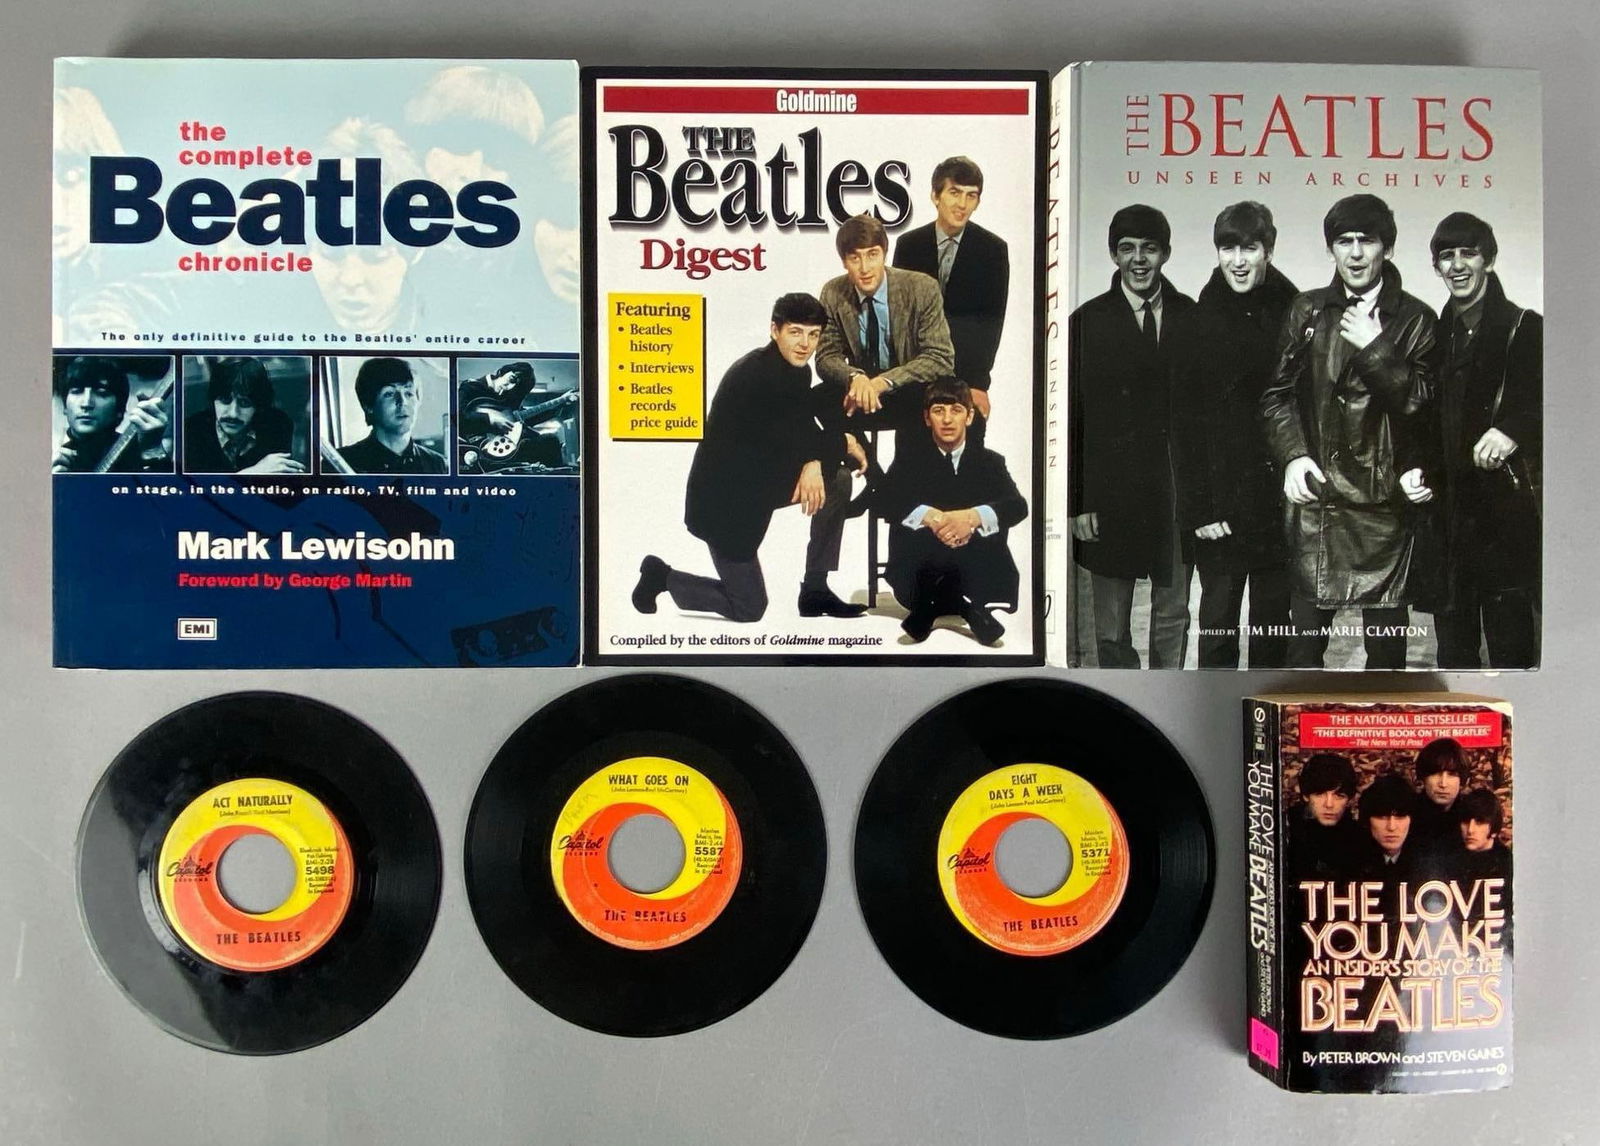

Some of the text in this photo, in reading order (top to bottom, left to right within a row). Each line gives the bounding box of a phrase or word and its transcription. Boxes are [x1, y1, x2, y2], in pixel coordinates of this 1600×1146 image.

[776, 89, 857, 113] Goldmine
[180, 122, 226, 141] the
[1126, 95, 1150, 156] THE
[1159, 93, 1495, 162] BEATLES
[682, 126, 756, 155] THE
[179, 147, 312, 169] complete
[608, 124, 913, 232] Beatles
[1127, 170, 1493, 189] UNSEEN ARCHIVES
[90, 156, 520, 248] Beatles
[178, 253, 312, 272] chronicle
[640, 238, 767, 280] Digest
[616, 302, 691, 320] Featuring
[101, 332, 526, 344] The only definitive guide to the Beatles' entire career
[630, 324, 672, 335] Beatles
[630, 340, 673, 355] history
[630, 362, 695, 374] Interviews
[630, 383, 673, 395] Beatles
[630, 400, 676, 411] records
[1048, 359, 1057, 468] UNSEEN
[631, 417, 698, 431] price guide
[112, 485, 517, 497] on stage, in the studio, on radio, TV, film and video
[178, 531, 455, 560] Mark Lewisohn
[179, 573, 412, 590] Foreword by George Martin
[184, 623, 211, 634] EMI
[1237, 625, 1264, 636] TIM
[1268, 625, 1298, 636] HILL
[1320, 625, 1363, 637] MARIE
[1366, 625, 1428, 637] CLAYTON
[610, 635, 883, 648] Compiled by the editors of Goldmine magazine
[1330, 714, 1351, 725] THE
[1354, 714, 1411, 725] NATIONAL
[1337, 729, 1387, 737] DEFINITIVE
[1389, 729, 1416, 737] BOOK
[1417, 729, 1432, 737] ON
[1434, 728, 1451, 737] THE
[1371, 739, 1388, 747] New
[1389, 739, 1406, 747] York
[1407, 739, 1423, 747] Post
[609, 775, 689, 786] WHAT GOES ON
[1011, 773, 1037, 785] EIGHT
[1248, 761, 1261, 799] YOU
[989, 784, 1063, 800] DAYS A WEEK
[213, 795, 292, 808] ACT NATURALLY
[1260, 763, 1275, 858] THE LOVE
[1248, 798, 1262, 854] MAKE
[558, 836, 604, 850] Capitol
[694, 847, 724, 856] 5587
[947, 852, 991, 870] Capitol
[1081, 848, 1110, 858] 5371
[166, 861, 213, 877] Capitol
[305, 866, 335, 875] 5498
[1250, 853, 1268, 951] BEATLES
[1300, 879, 1504, 923] THE LOVE
[605, 910, 686, 923] THE BEATLES
[1003, 915, 1078, 932] THE BEATLES
[217, 931, 301, 945] THE BEATLES
[1302, 919, 1504, 960] YOU MAKE
[1303, 956, 1504, 977] AN INSIDER'S STORY OF THE
[1301, 975, 1504, 1033] BEATLES
[1302, 1047, 1504, 1066] By PETER BROWN and STEVEN GAINES
